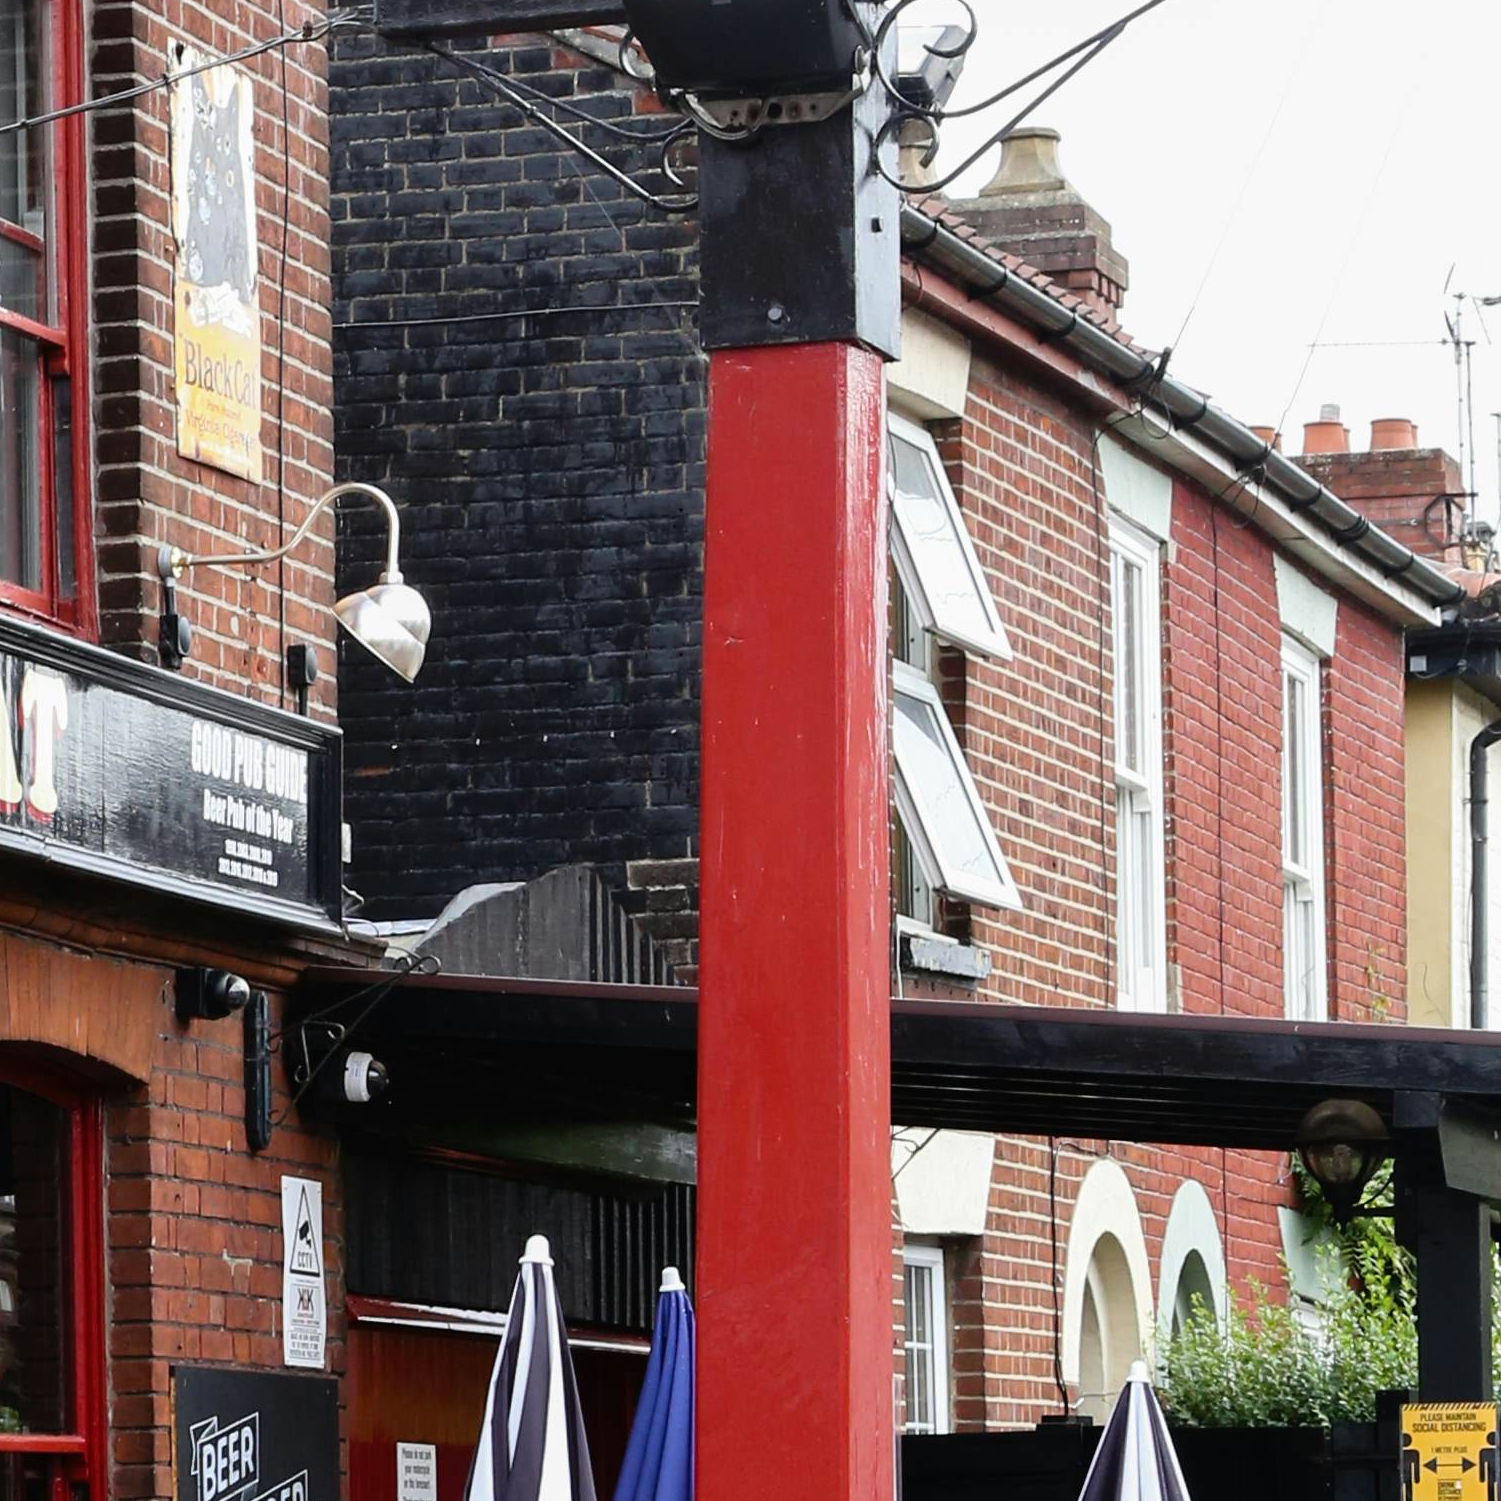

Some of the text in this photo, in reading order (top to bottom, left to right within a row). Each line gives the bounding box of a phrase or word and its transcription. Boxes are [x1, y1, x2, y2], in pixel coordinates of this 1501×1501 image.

[191, 720, 308, 804] GOOD PUB GUIDE
[245, 802, 256, 833] of
[1412, 1422, 1487, 1433] SOCIAL DISTANCING
